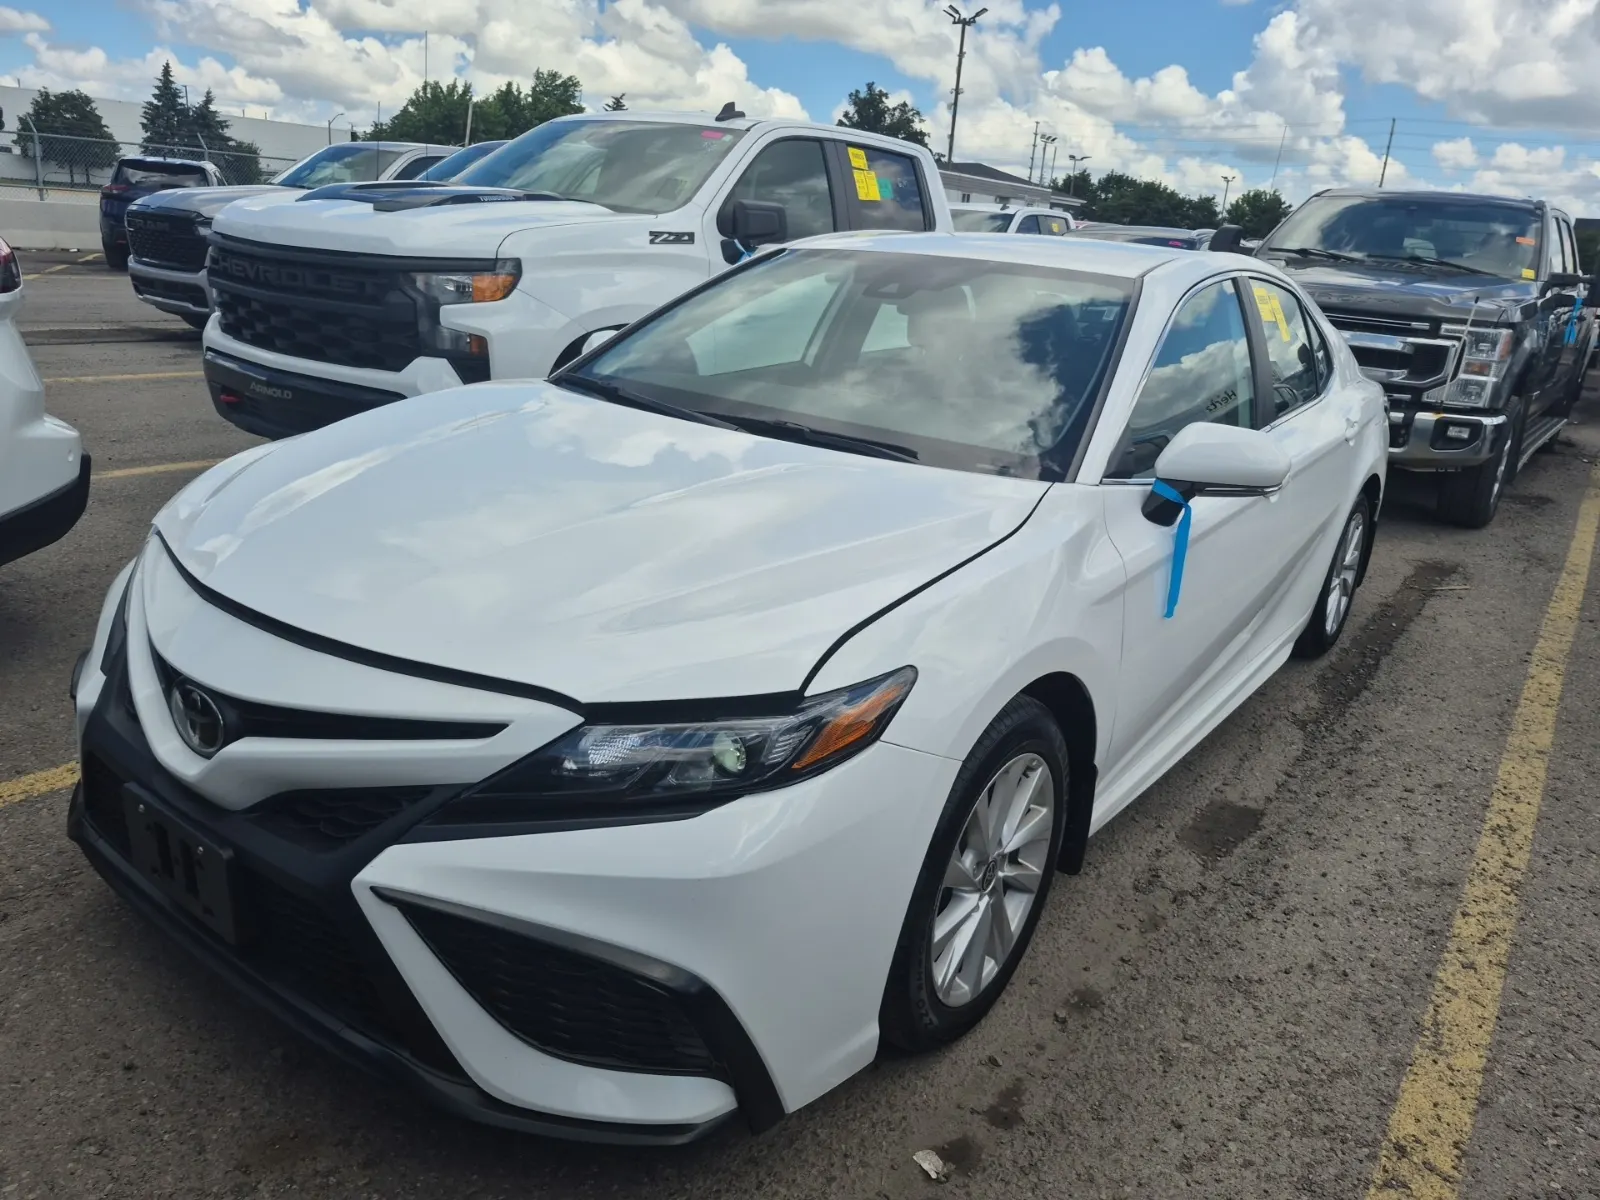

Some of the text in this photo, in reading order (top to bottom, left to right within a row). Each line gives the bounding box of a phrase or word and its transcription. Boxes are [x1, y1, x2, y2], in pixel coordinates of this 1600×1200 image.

[648, 231, 695, 246] Z71
[209, 252, 387, 298] CHEVROLET
[249, 381, 293, 400] ARNOLD
